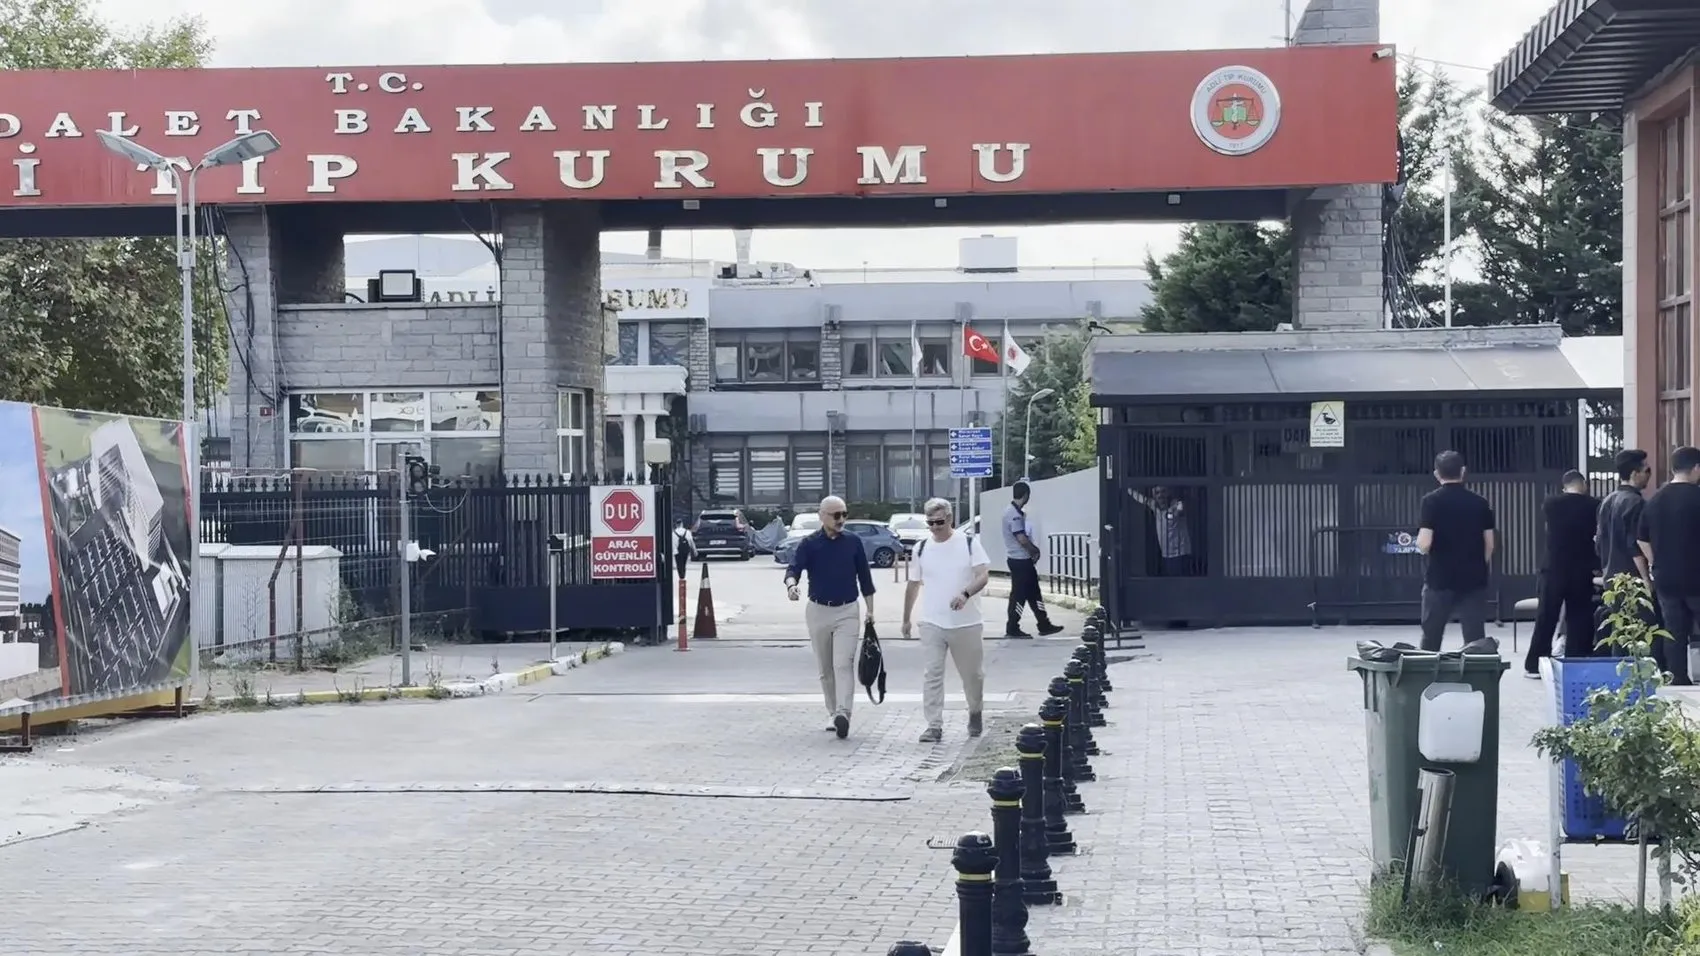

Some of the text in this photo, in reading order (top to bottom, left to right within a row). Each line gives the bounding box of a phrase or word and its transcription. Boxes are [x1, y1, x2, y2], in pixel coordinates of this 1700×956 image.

[326, 73, 425, 93] T.C.
[0, 88, 825, 138] DALET BAKANLIĞI
[136, 152, 358, 195] TIP
[451, 142, 1031, 192] KURUMU
[605, 503, 640, 519] DUR
[608, 540, 638, 549] ARAÇ
[595, 551, 651, 561] GÜVENLİK
[594, 562, 653, 573] KONTROLÜ
